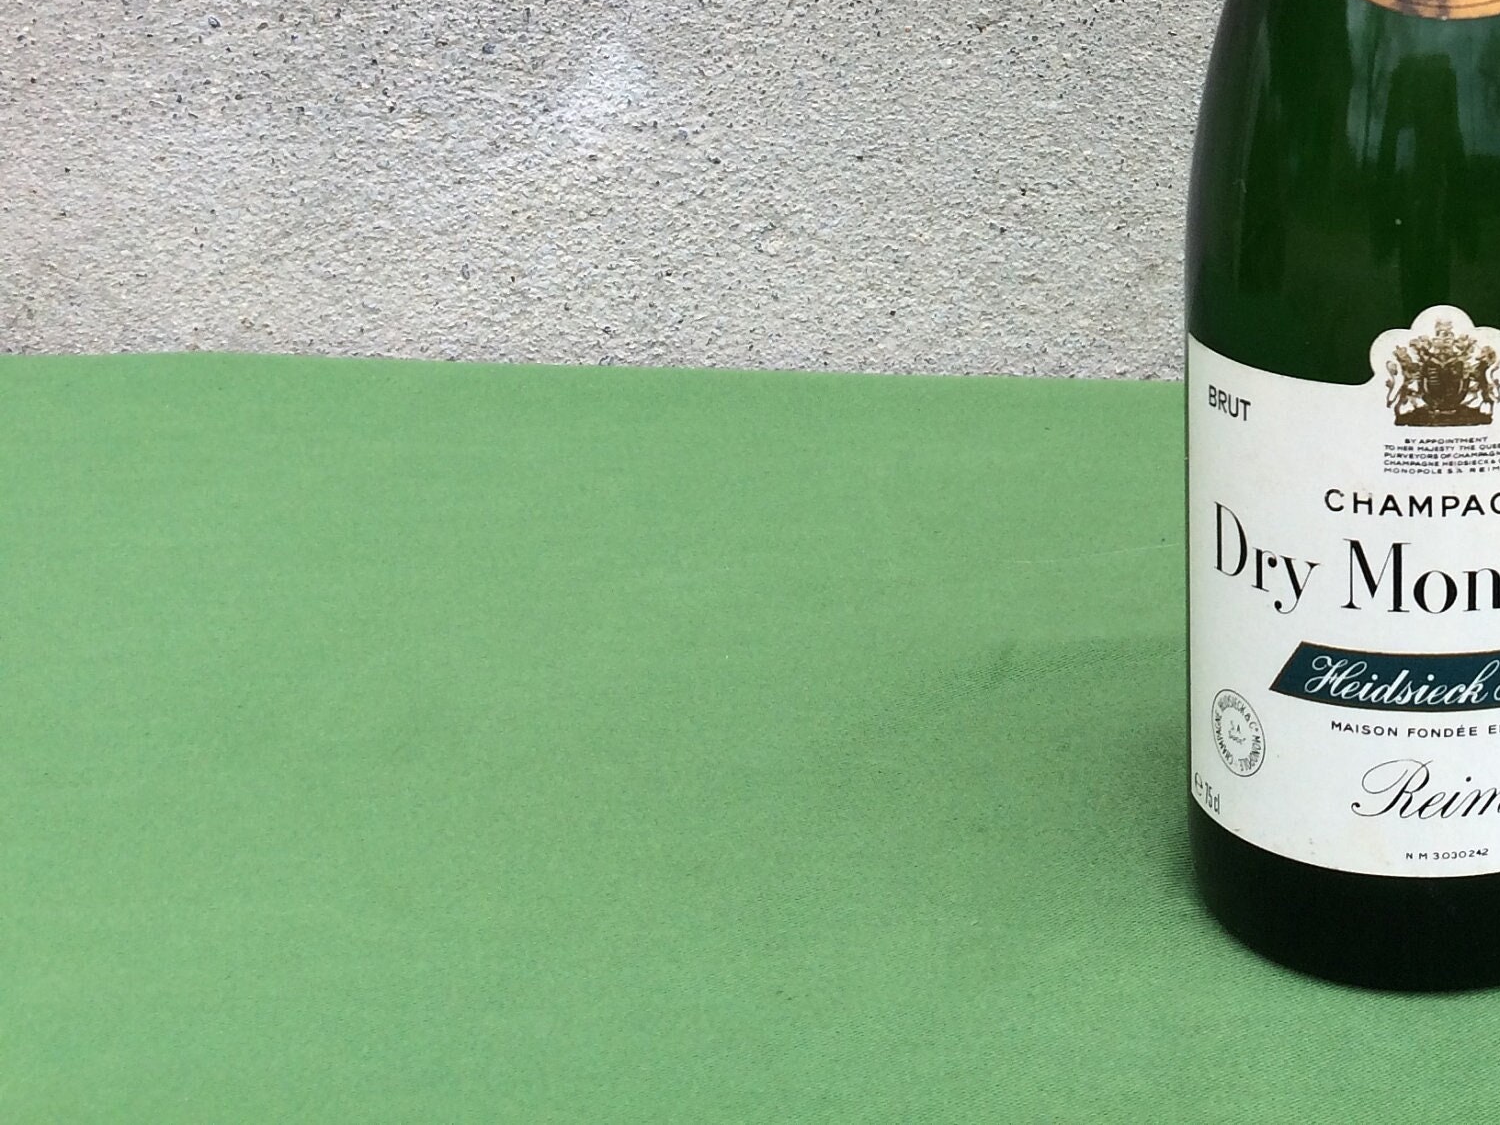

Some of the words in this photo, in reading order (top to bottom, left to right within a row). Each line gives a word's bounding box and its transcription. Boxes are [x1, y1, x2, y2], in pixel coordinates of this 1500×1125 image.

[1208, 384, 1251, 421] BRUT
[1419, 436, 1488, 444] APPOINTMENT
[1384, 459, 1439, 467] CHAMPAGNE
[1213, 500, 1321, 614] Dry
[1304, 655, 1499, 706] Heidsieck
[1331, 720, 1398, 737] MAISON
[1407, 725, 1478, 738] FONDÉE
